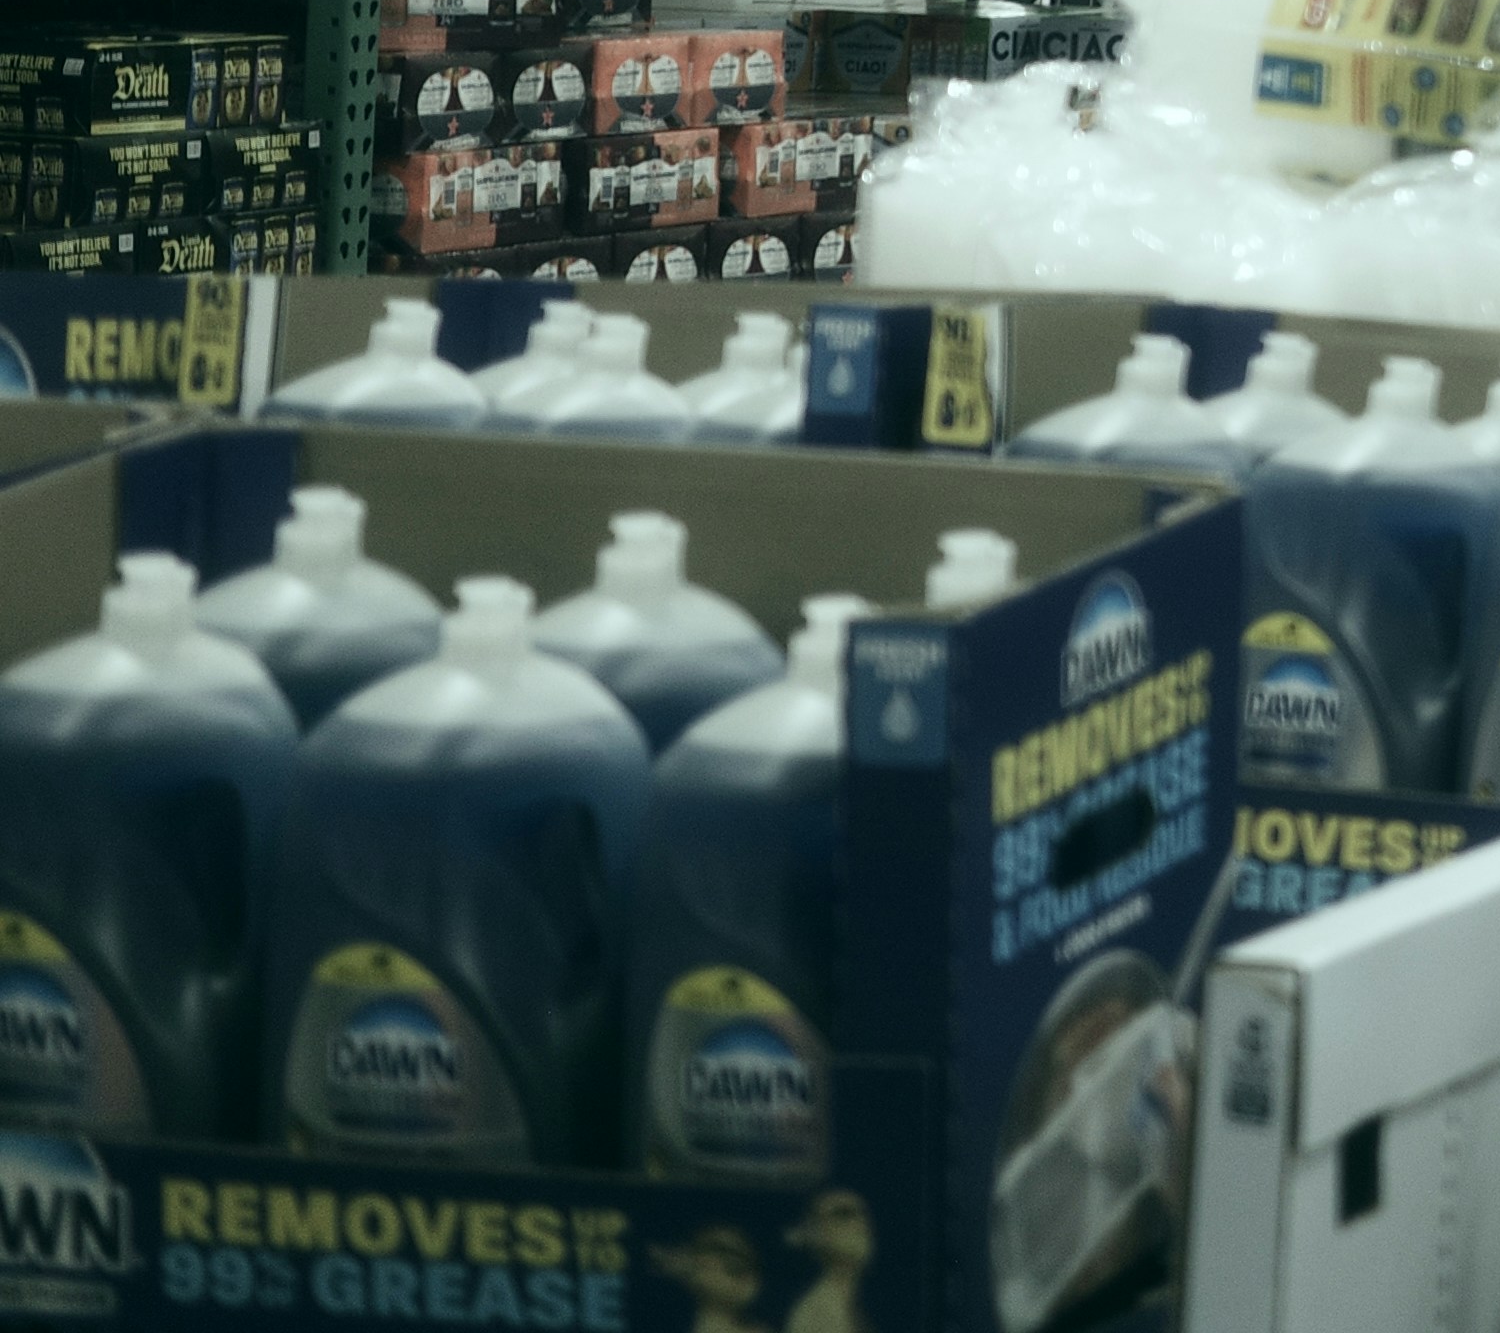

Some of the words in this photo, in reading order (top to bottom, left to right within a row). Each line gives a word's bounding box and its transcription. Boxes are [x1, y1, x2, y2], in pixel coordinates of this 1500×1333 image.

[845, 60, 887, 75] CIAO!
[113, 63, 169, 100] Death
[109, 146, 126, 162] YOU
[126, 144, 151, 161] WON'T
[150, 141, 179, 159] BELIEVE
[131, 160, 149, 175] NOT
[40, 241, 57, 257] YOU
[57, 239, 82, 256] WON'T
[82, 236, 111, 254] BELIEVE
[160, 236, 215, 272] Death
[63, 255, 80, 271] NOT
[160, 1177, 567, 1265] REMOVES
[311, 1250, 628, 1333] GREASE
